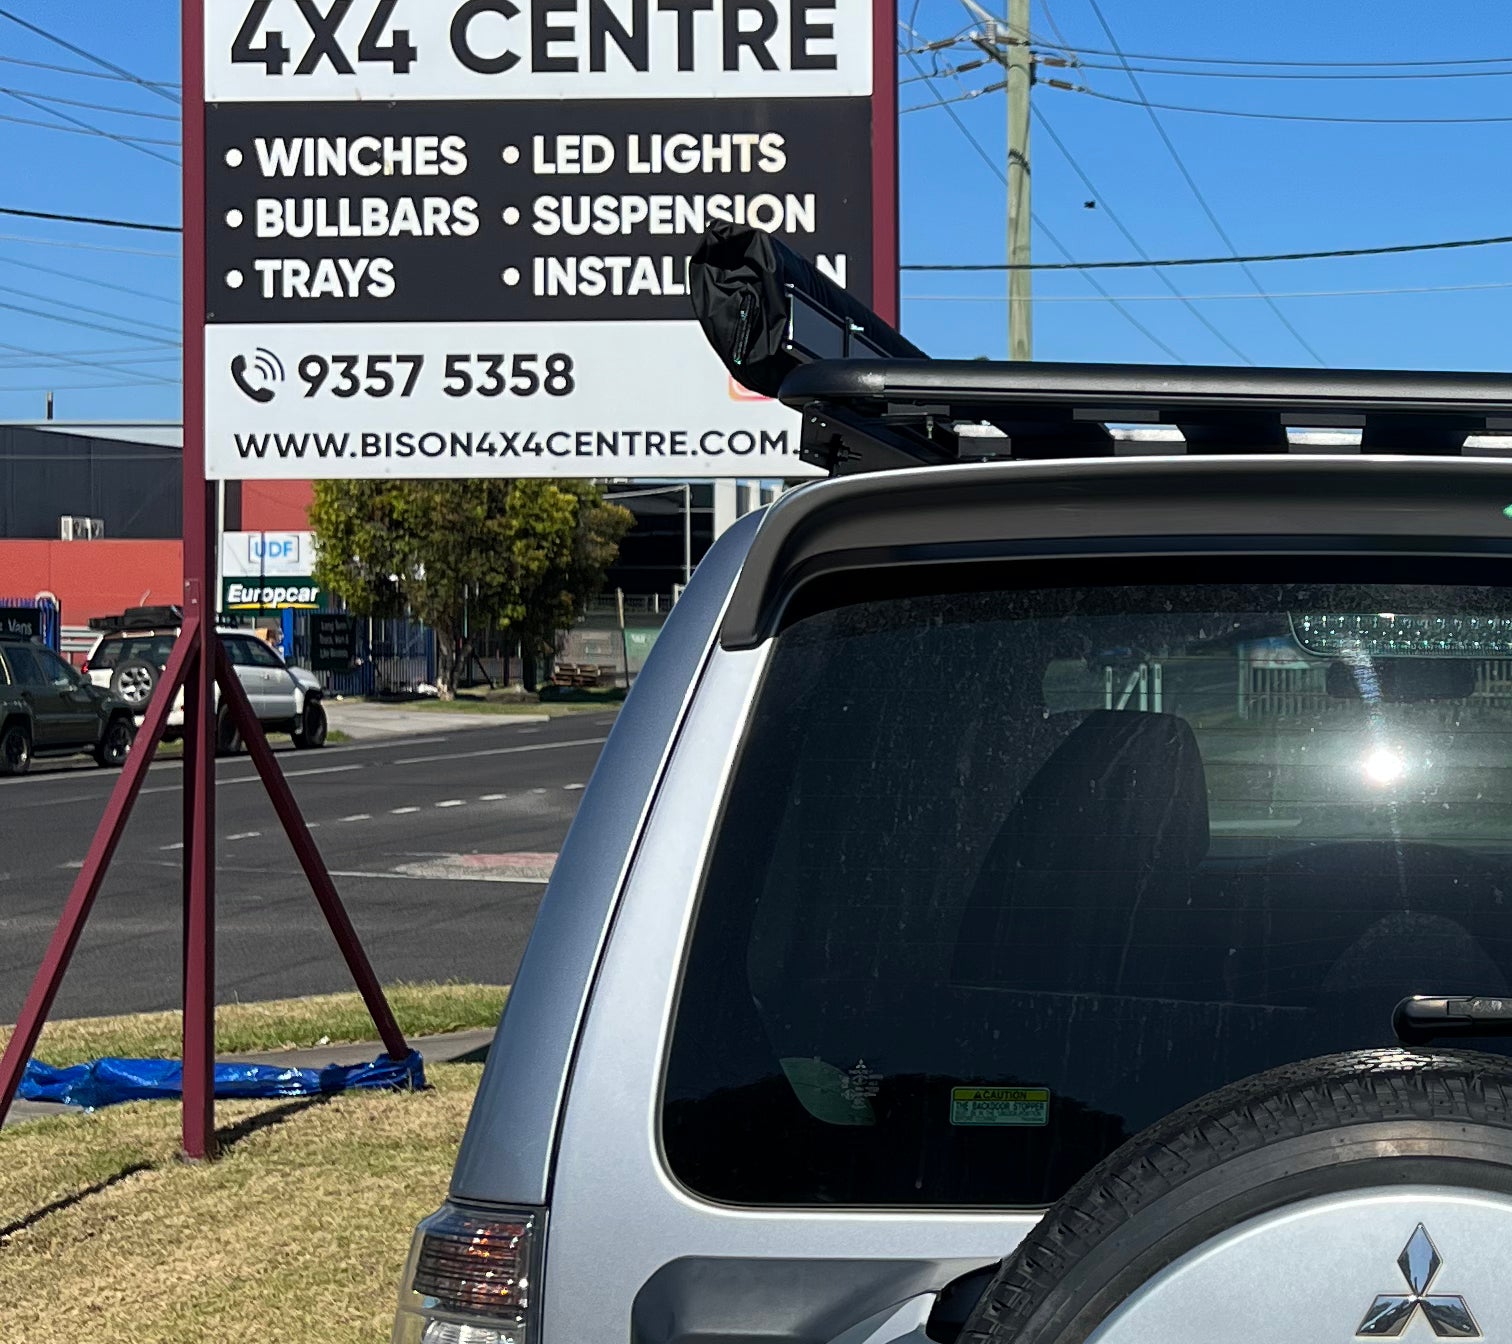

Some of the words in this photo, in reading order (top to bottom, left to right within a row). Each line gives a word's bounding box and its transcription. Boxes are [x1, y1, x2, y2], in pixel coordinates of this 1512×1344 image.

[254, 135, 469, 176] WINCHES
[531, 134, 615, 175] LED
[627, 132, 787, 174] LIGHTS
[254, 197, 480, 238] BULLBARS
[531, 194, 816, 236] SUSPENSION
[254, 258, 396, 299] TRAYS
[298, 353, 424, 399] 9357
[443, 352, 575, 398] 5358
[254, 541, 294, 558] UDF
[227, 583, 321, 608] Europcar
[983, 1090, 1027, 1100] CAUTION
